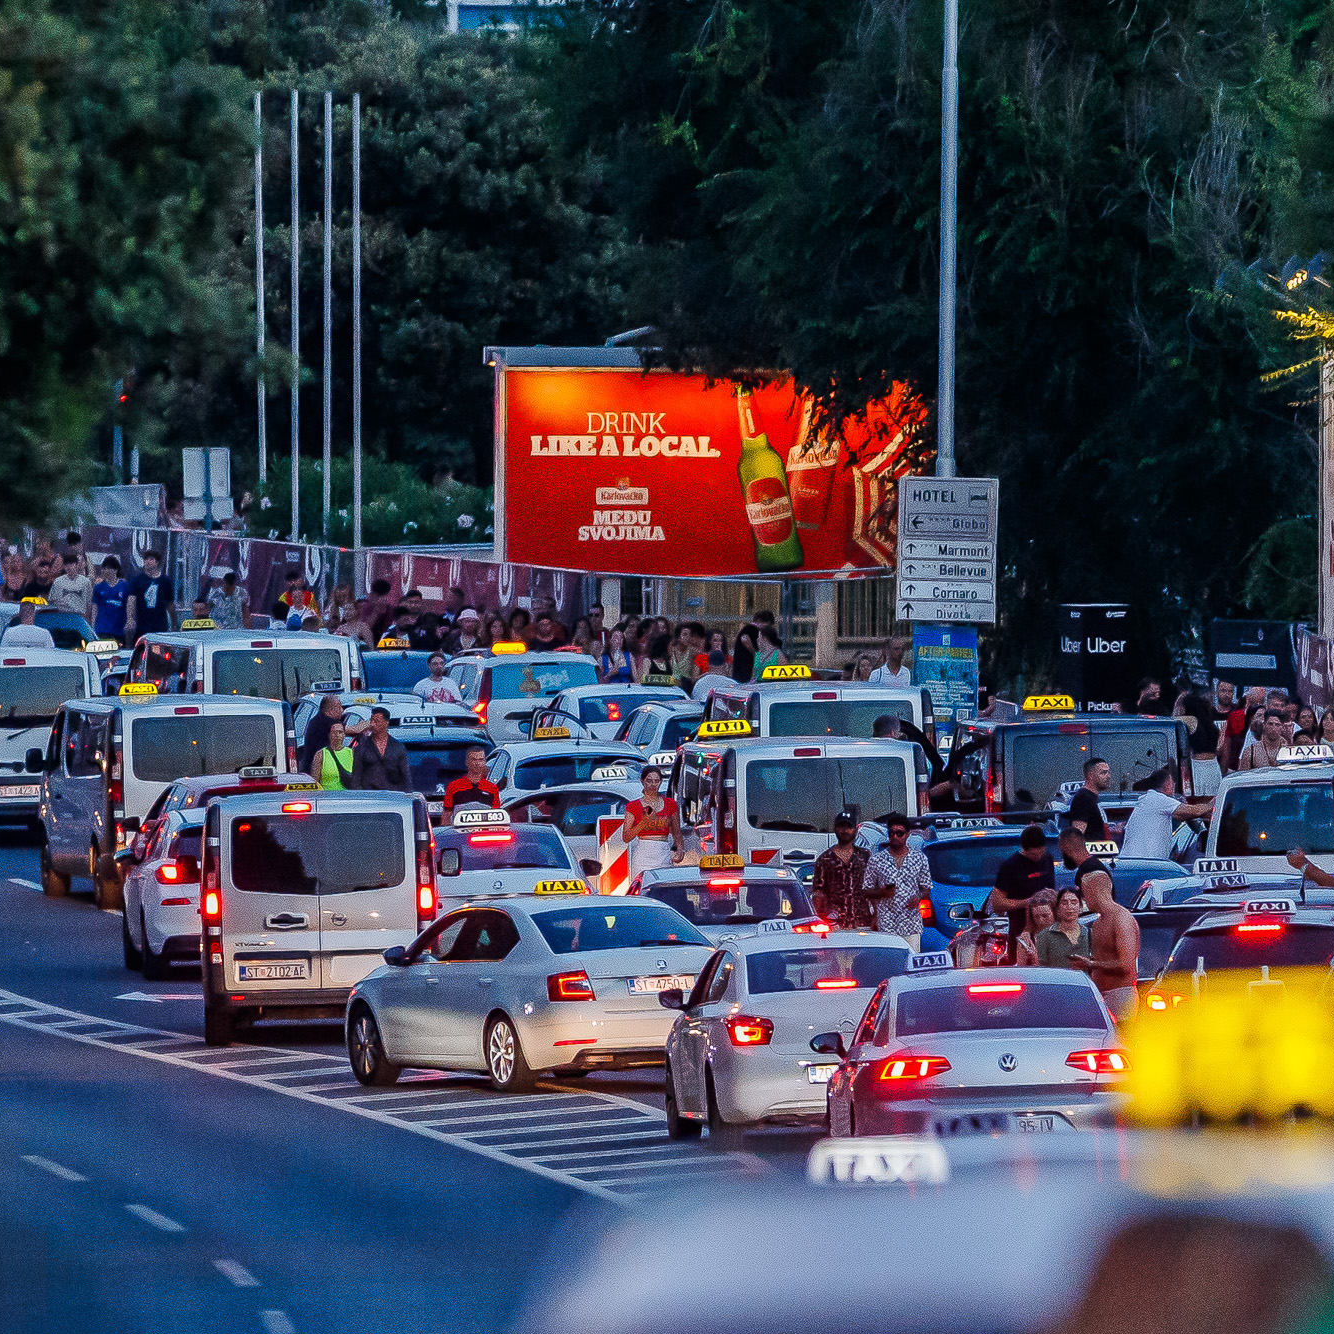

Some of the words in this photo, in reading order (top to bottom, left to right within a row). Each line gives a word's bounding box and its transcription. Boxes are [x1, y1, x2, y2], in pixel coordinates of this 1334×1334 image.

[586, 412, 666, 434] DRINK
[530, 435, 597, 457] LIKE
[599, 435, 620, 457] A
[622, 435, 721, 458] LOCAL.
[913, 489, 956, 503] HOTEL
[952, 518, 986, 530] Globo
[578, 525, 665, 541] SVOJIMA
[938, 543, 989, 557] Marmont
[939, 564, 987, 577] Bellevue
[932, 586, 978, 599] Cornaro
[188, 619, 211, 628] TAXI
[1060, 636, 1081, 653] Uber
[1087, 637, 1127, 653] Uber
[770, 667, 805, 676] TAXI
[1030, 698, 1069, 708] TAXI
[706, 721, 745, 733] TAXI
[1288, 747, 1321, 757] TAXI
[600, 768, 626, 779] TAXI
[461, 813, 483, 822] TAXI
[487, 812, 503, 821] 503
[708, 856, 736, 866] TAXI
[1202, 860, 1237, 871] TAXI
[1213, 875, 1245, 885] TAXI
[544, 881, 582, 892] TAXI
[1251, 903, 1286, 911] TAXI
[762, 921, 787, 932] TAXI
[914, 954, 945, 967] TAXI
[247, 967, 259, 978] ST
